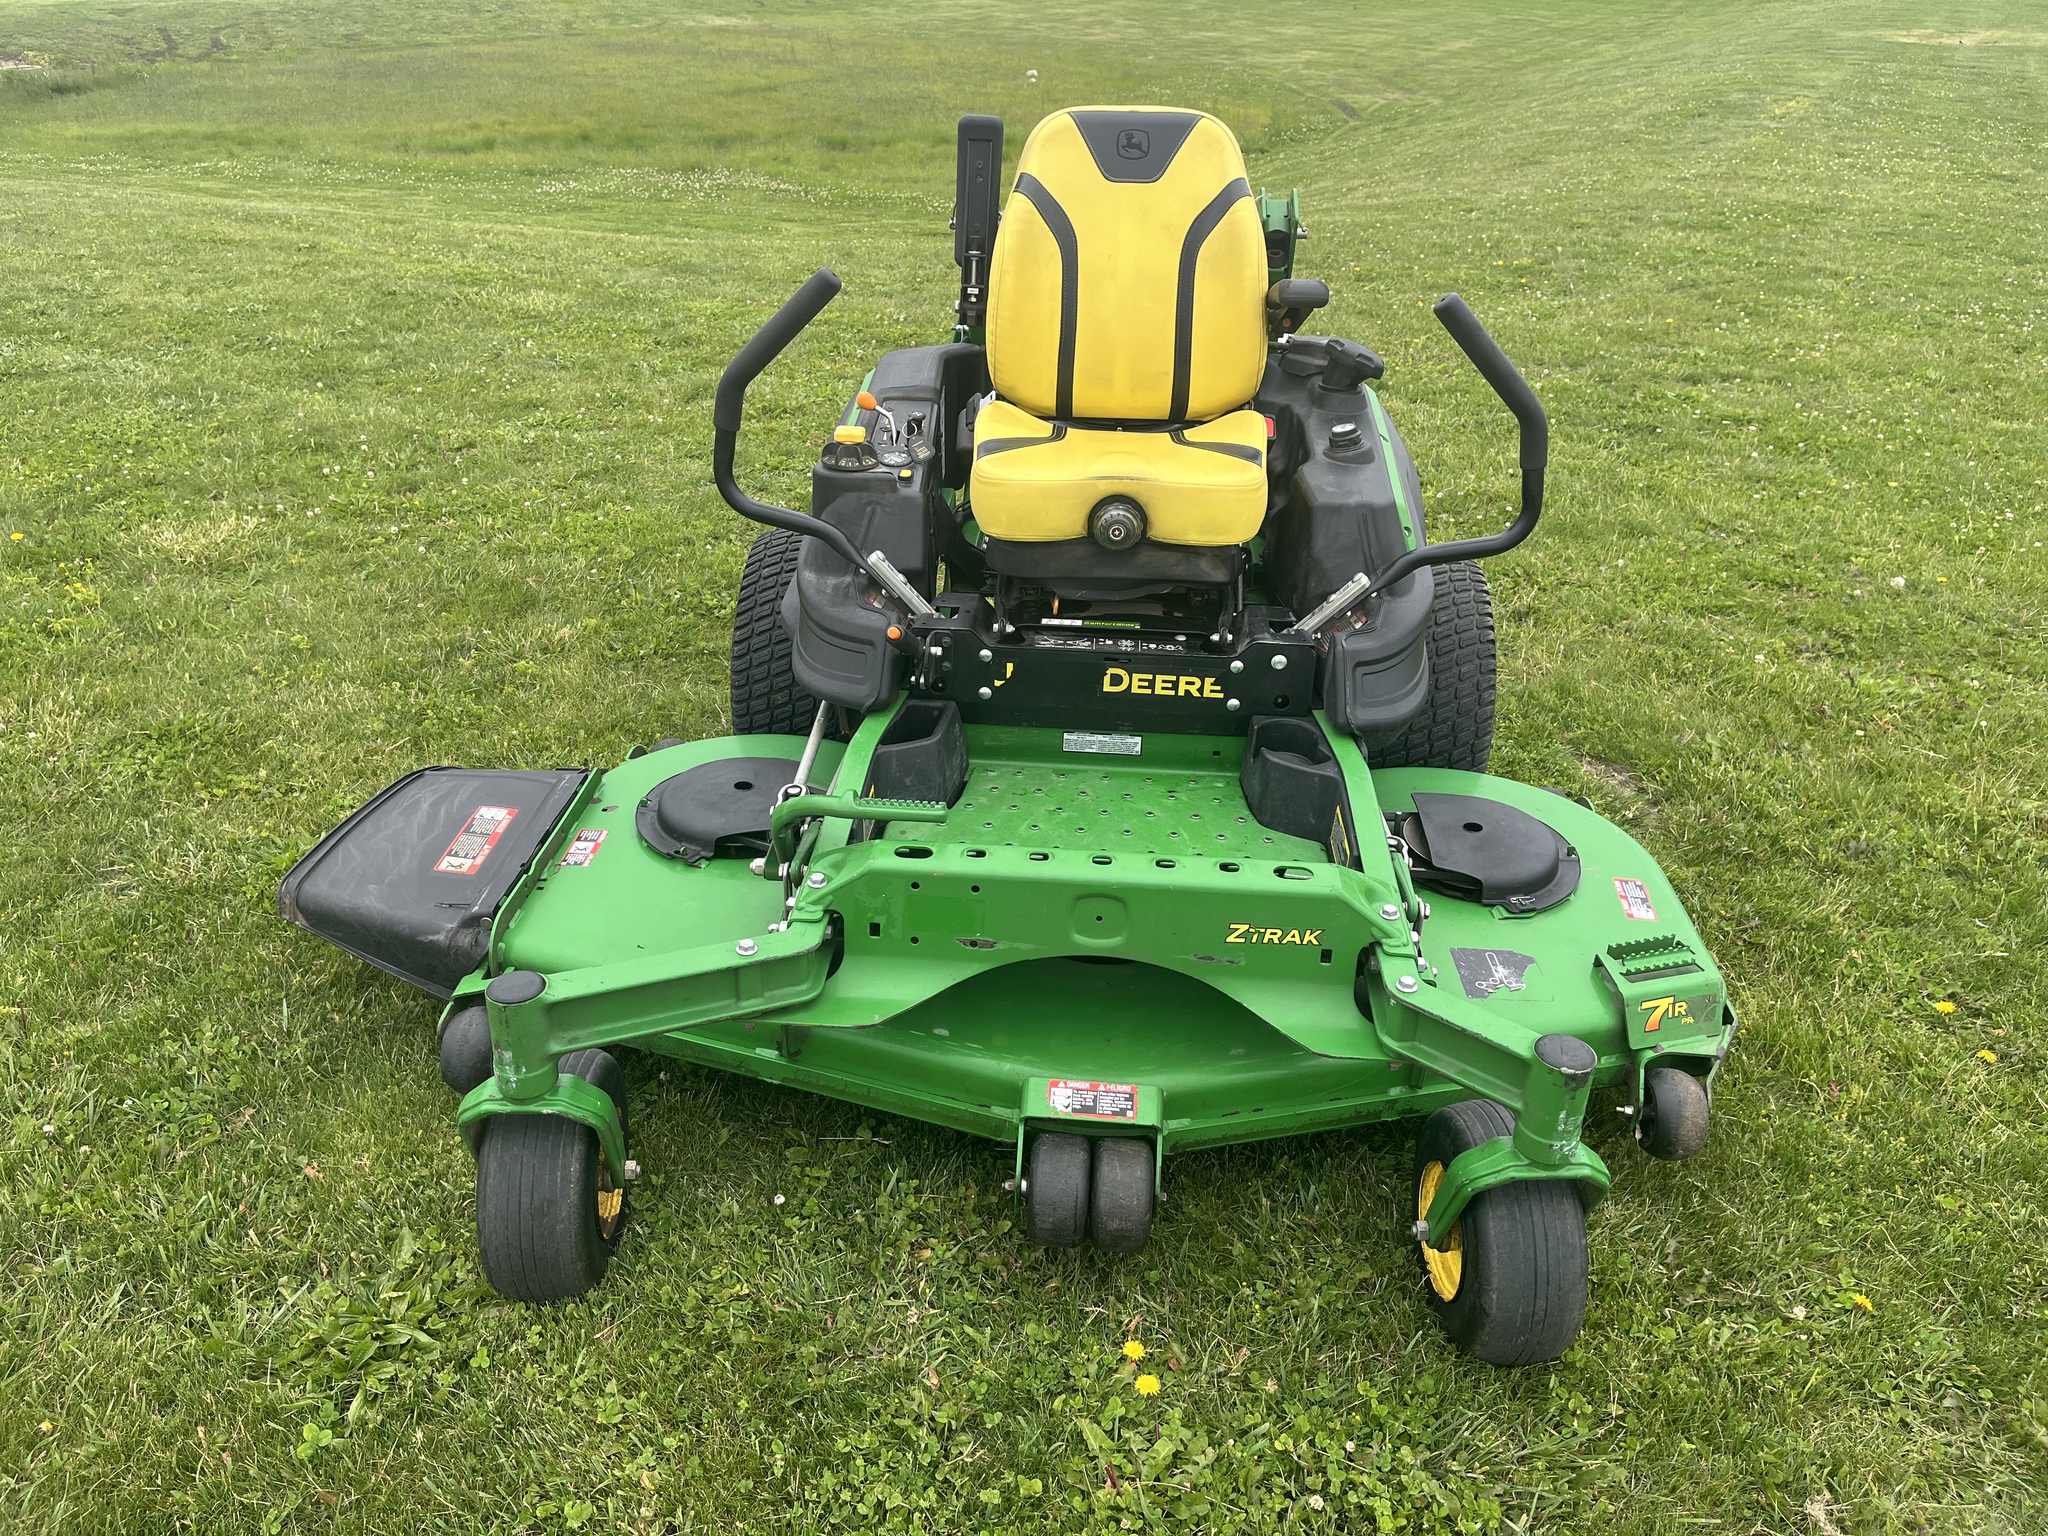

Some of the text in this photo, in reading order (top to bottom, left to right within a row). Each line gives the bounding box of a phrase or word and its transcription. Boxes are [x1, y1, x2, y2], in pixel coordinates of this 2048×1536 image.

[1103, 667, 1225, 699] DEERE
[1224, 923, 1325, 946] ZTRAK
[1066, 1080, 1090, 1090] DANGER
